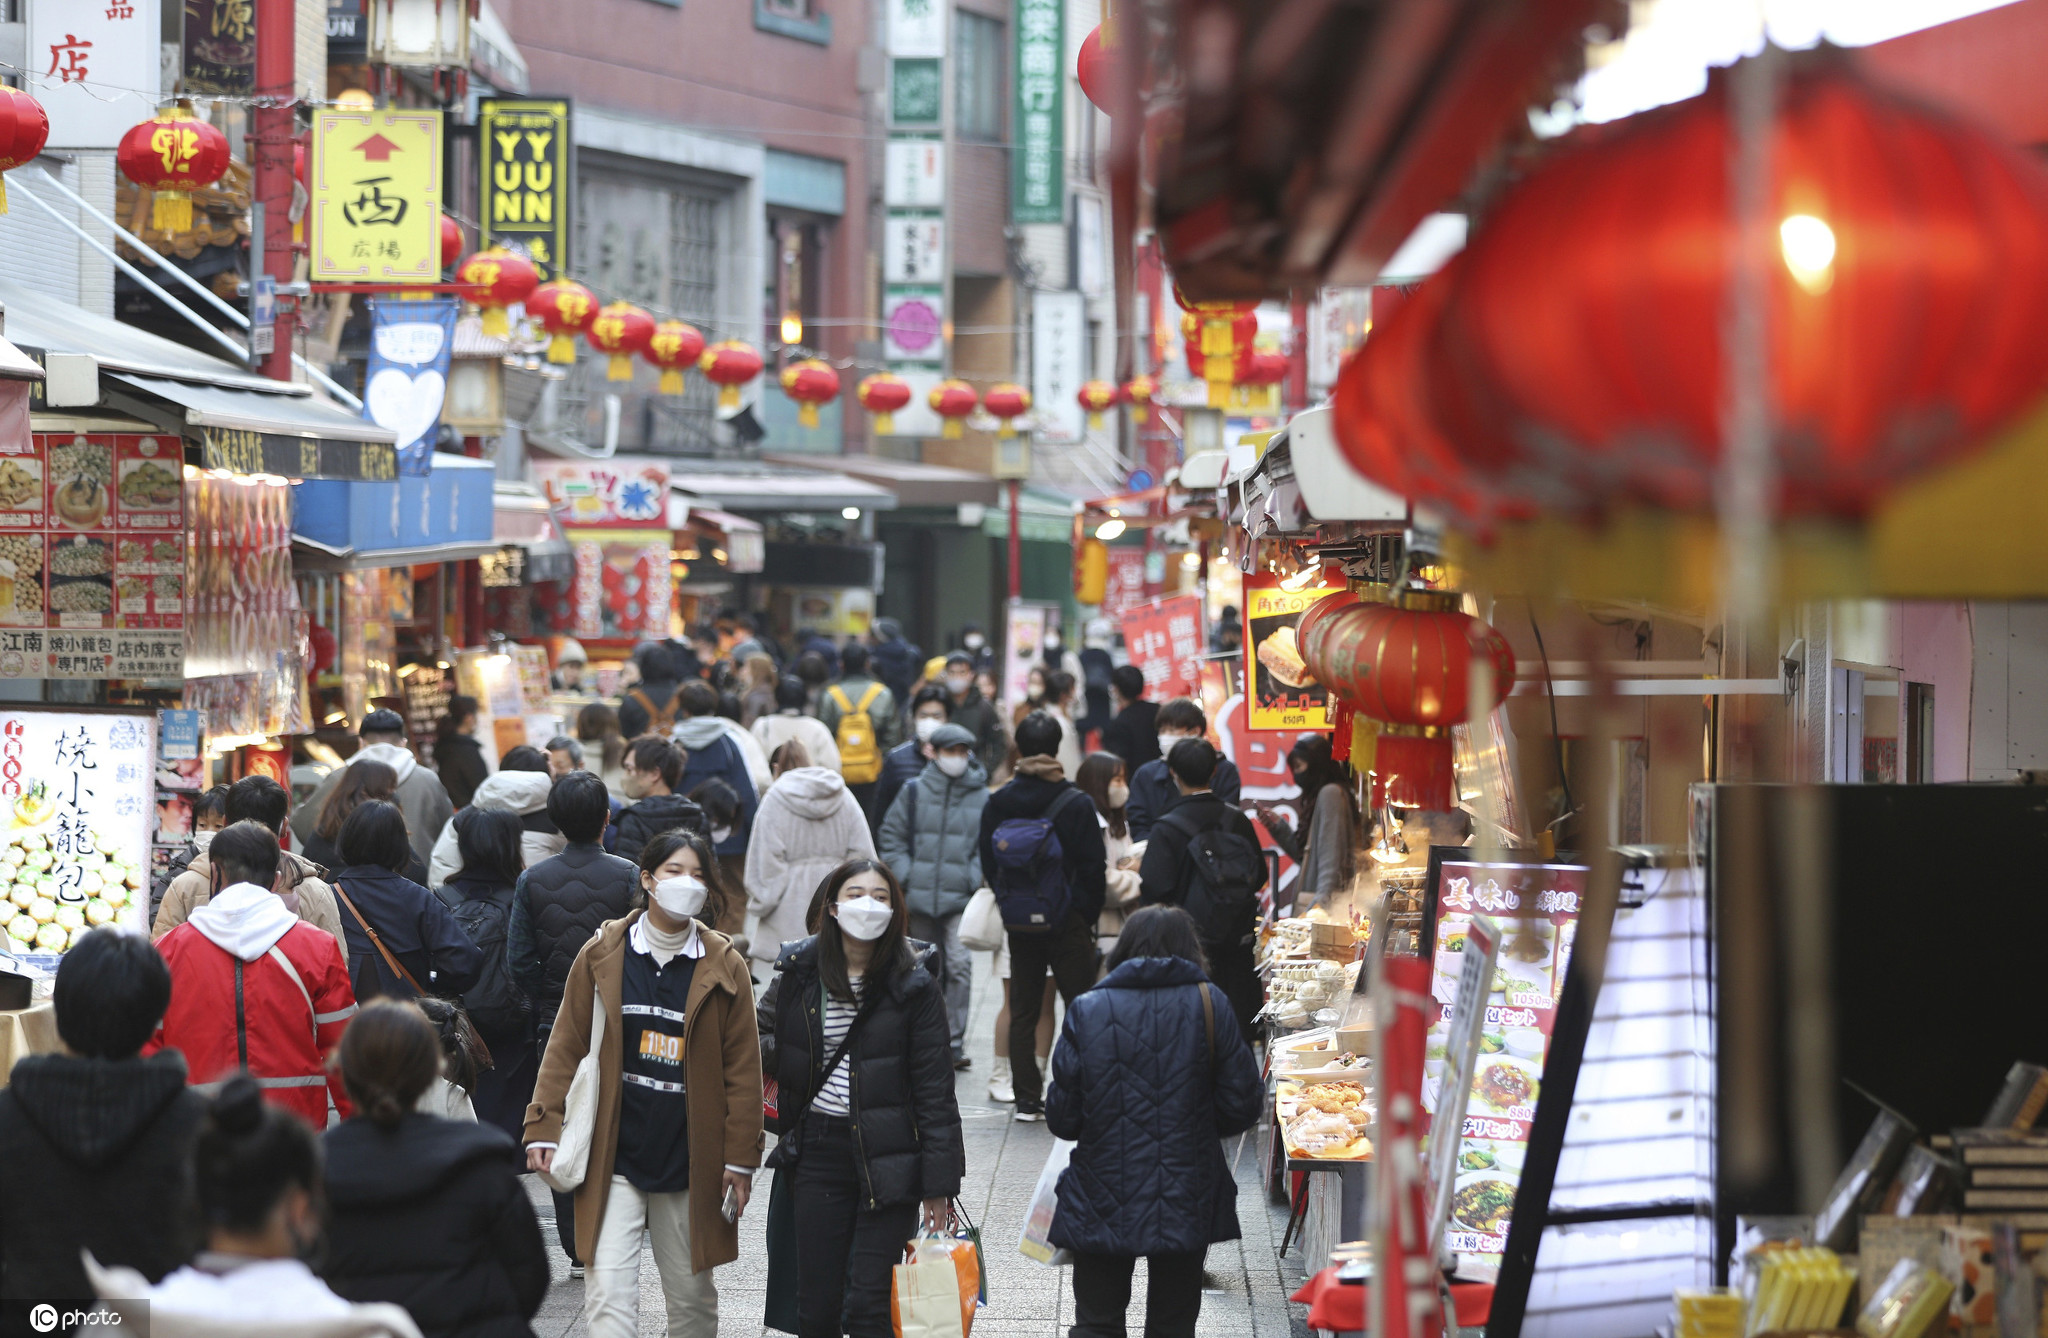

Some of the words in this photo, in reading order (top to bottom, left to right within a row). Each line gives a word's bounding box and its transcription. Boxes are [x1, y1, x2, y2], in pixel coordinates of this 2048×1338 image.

[45, 34, 93, 83] 店
[343, 176, 408, 227] 西
[351, 240, 401, 260] 広場
[116, 641, 183, 658] 店内席で
[1442, 877, 1578, 913] 美味し料理
[1513, 993, 1552, 1006] 1050円
